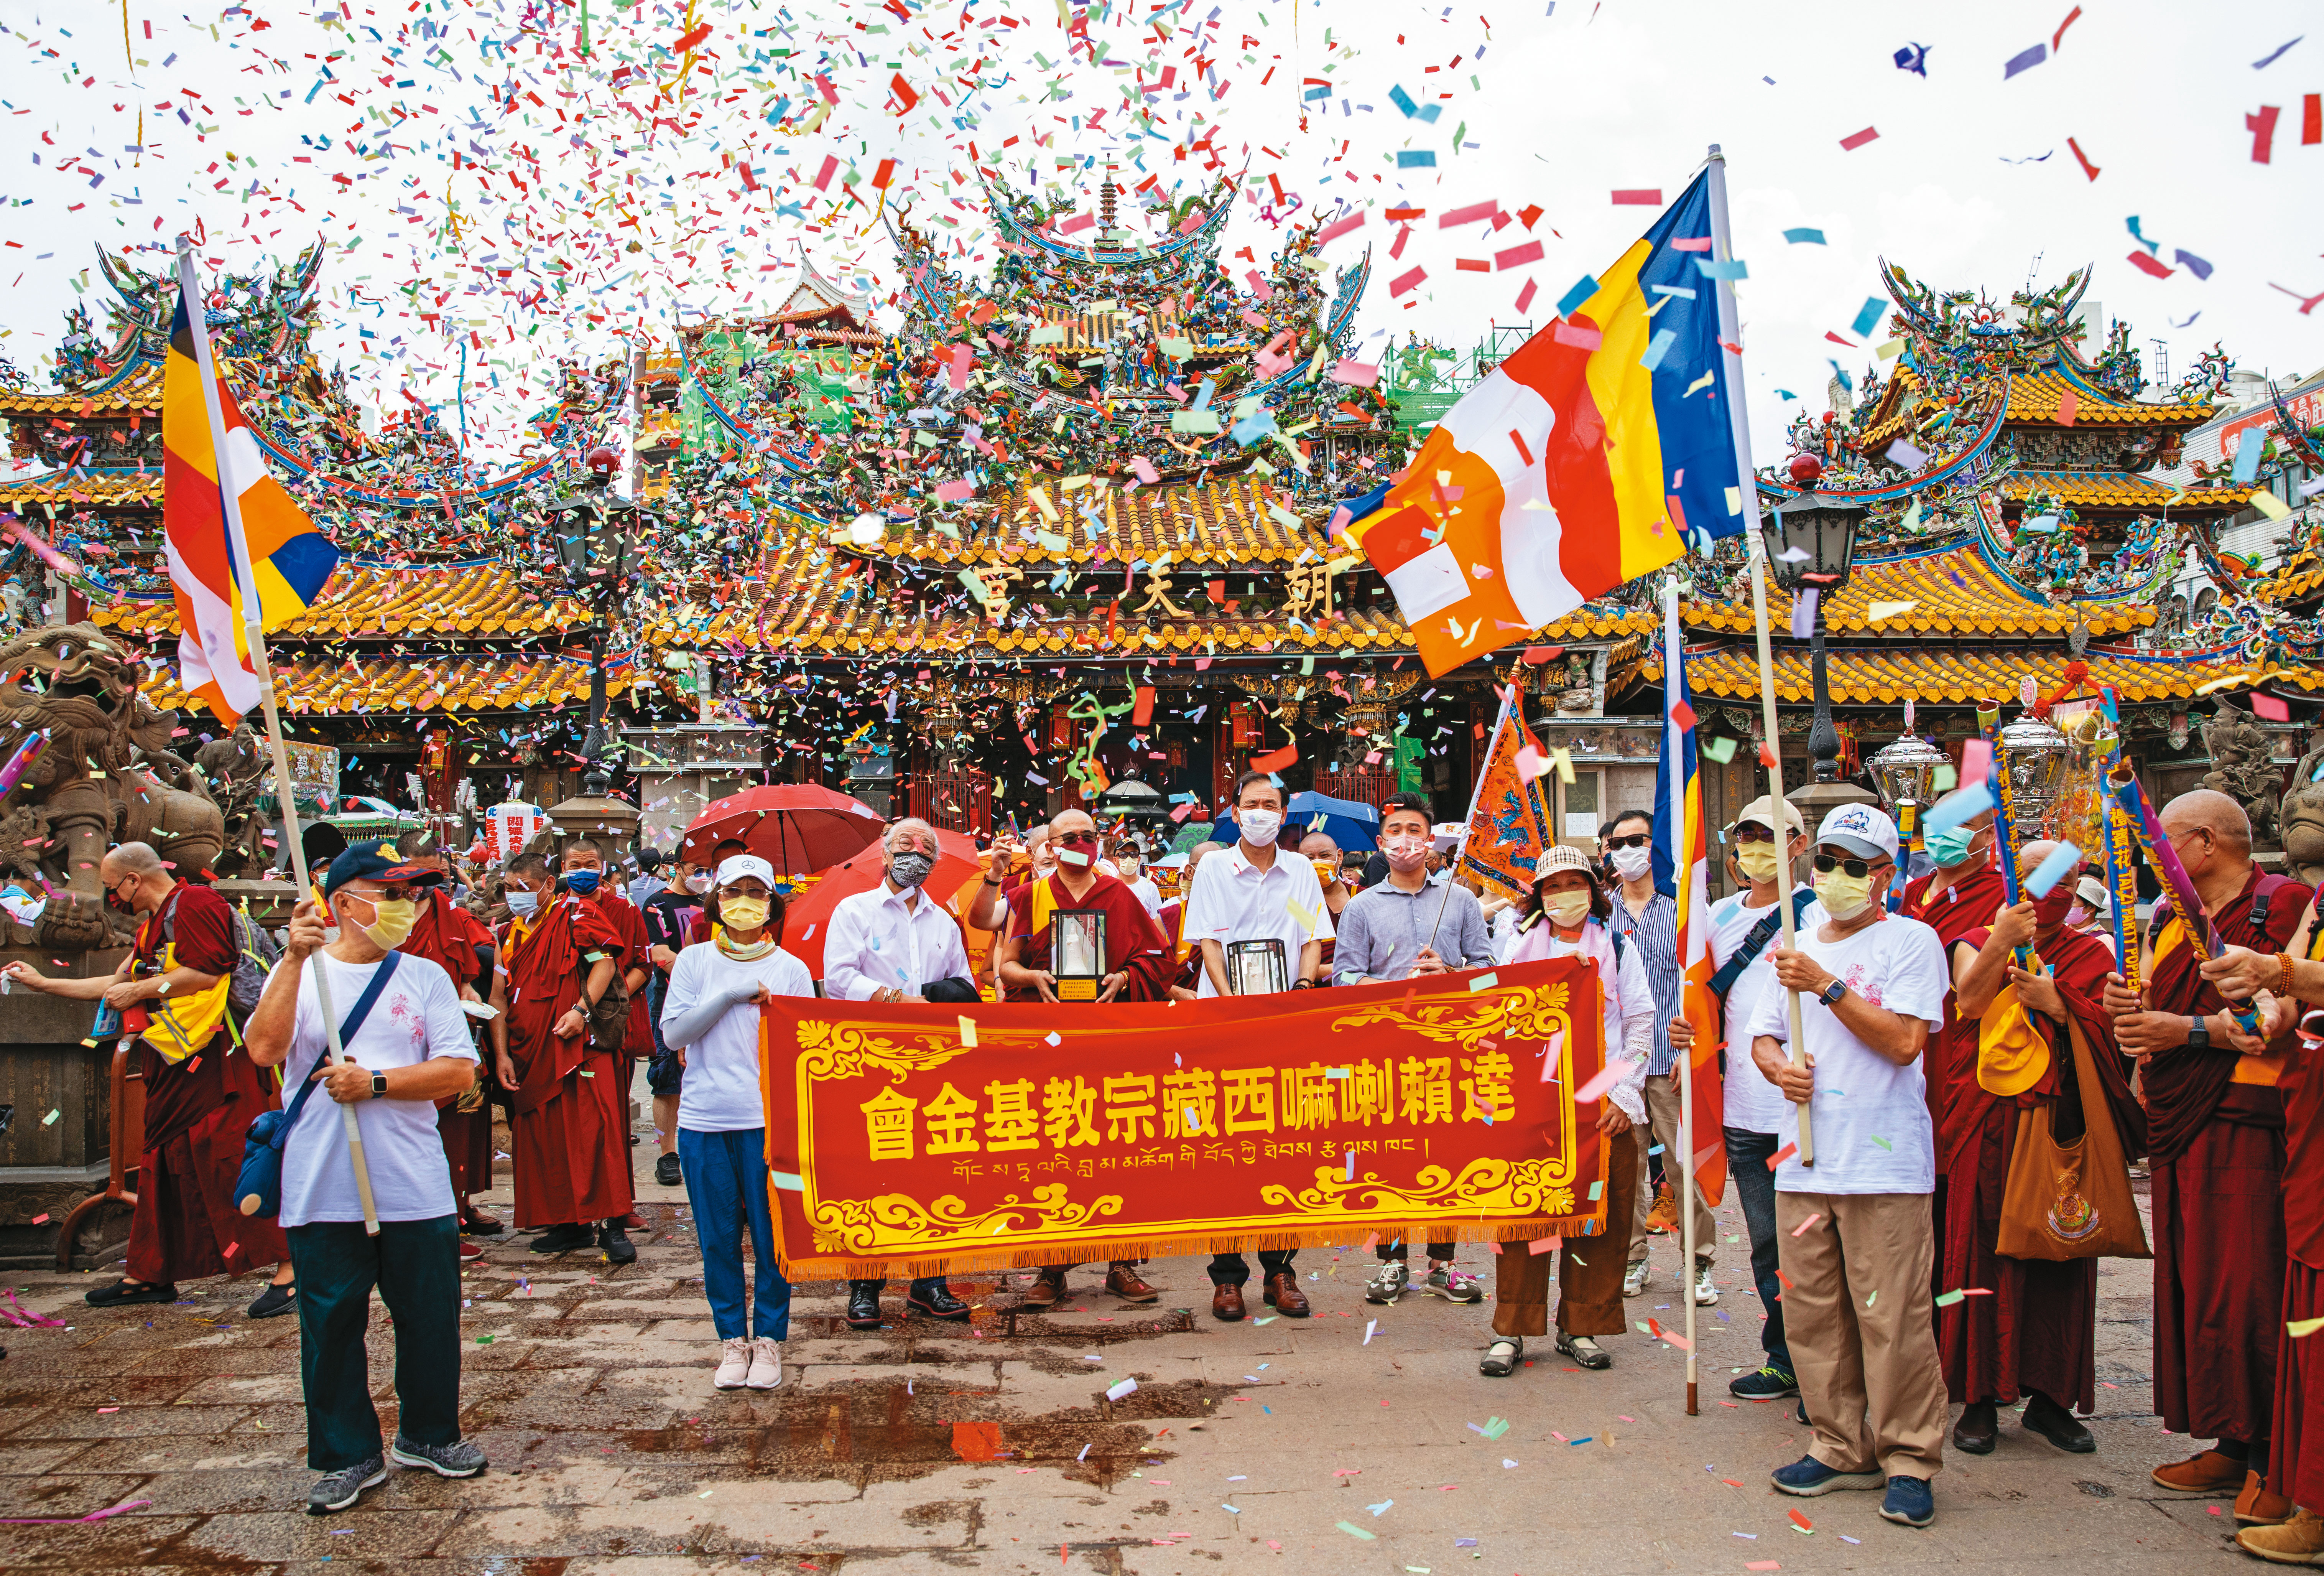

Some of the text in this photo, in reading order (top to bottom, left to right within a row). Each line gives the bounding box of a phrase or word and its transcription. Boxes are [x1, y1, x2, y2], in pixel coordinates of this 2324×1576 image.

[974, 557, 1332, 619] 朝天宮
[2118, 870, 2133, 891] TAI
[2122, 906, 2137, 944] PARTY
[2125, 947, 2141, 993] POPPER
[859, 1051, 1515, 1162] 達賴喇嘛西藏宗教基金會
[2045, 1228, 2076, 1245] PEKANBARU
[2079, 1227, 2104, 1244] INDONESIA
